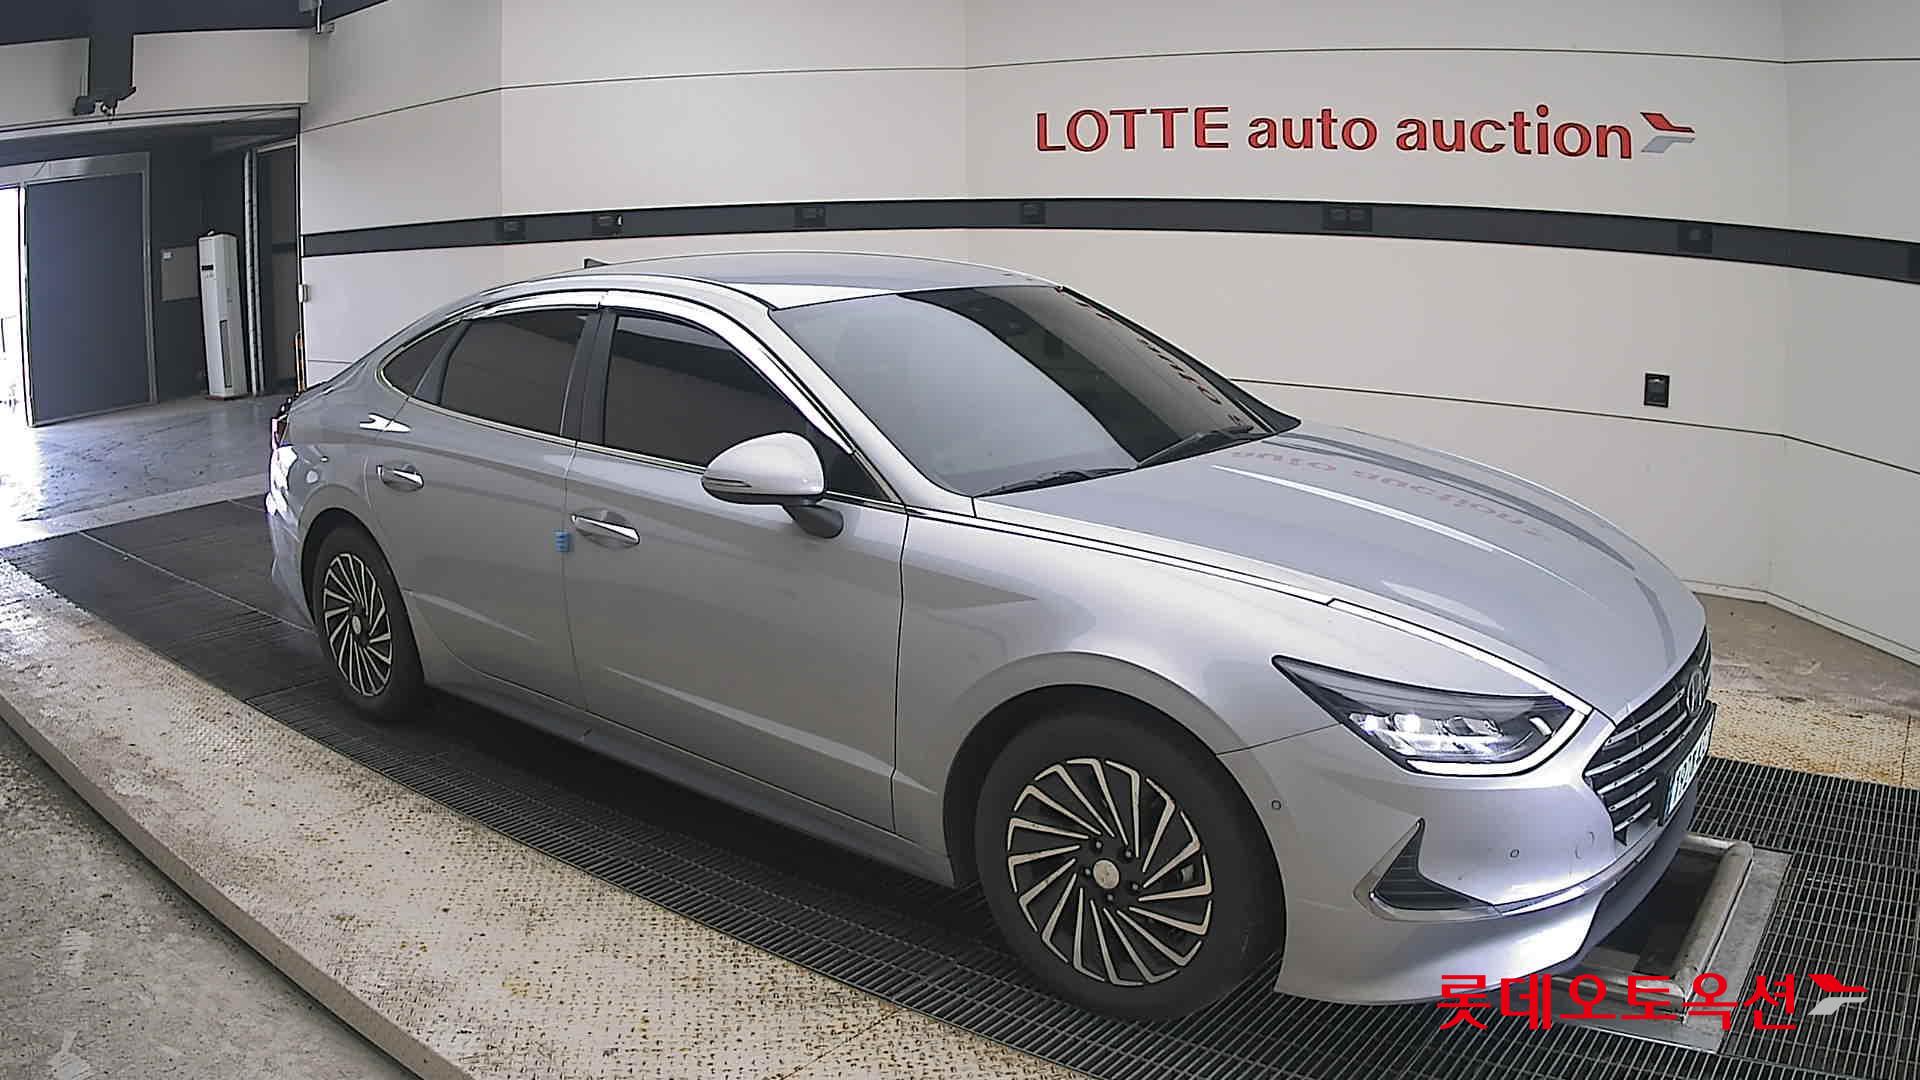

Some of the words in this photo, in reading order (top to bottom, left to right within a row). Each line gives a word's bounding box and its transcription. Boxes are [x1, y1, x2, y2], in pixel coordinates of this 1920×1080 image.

[1037, 107, 1229, 152] LOTTE
[1248, 108, 1378, 152] auto
[1396, 105, 1633, 158] auction
